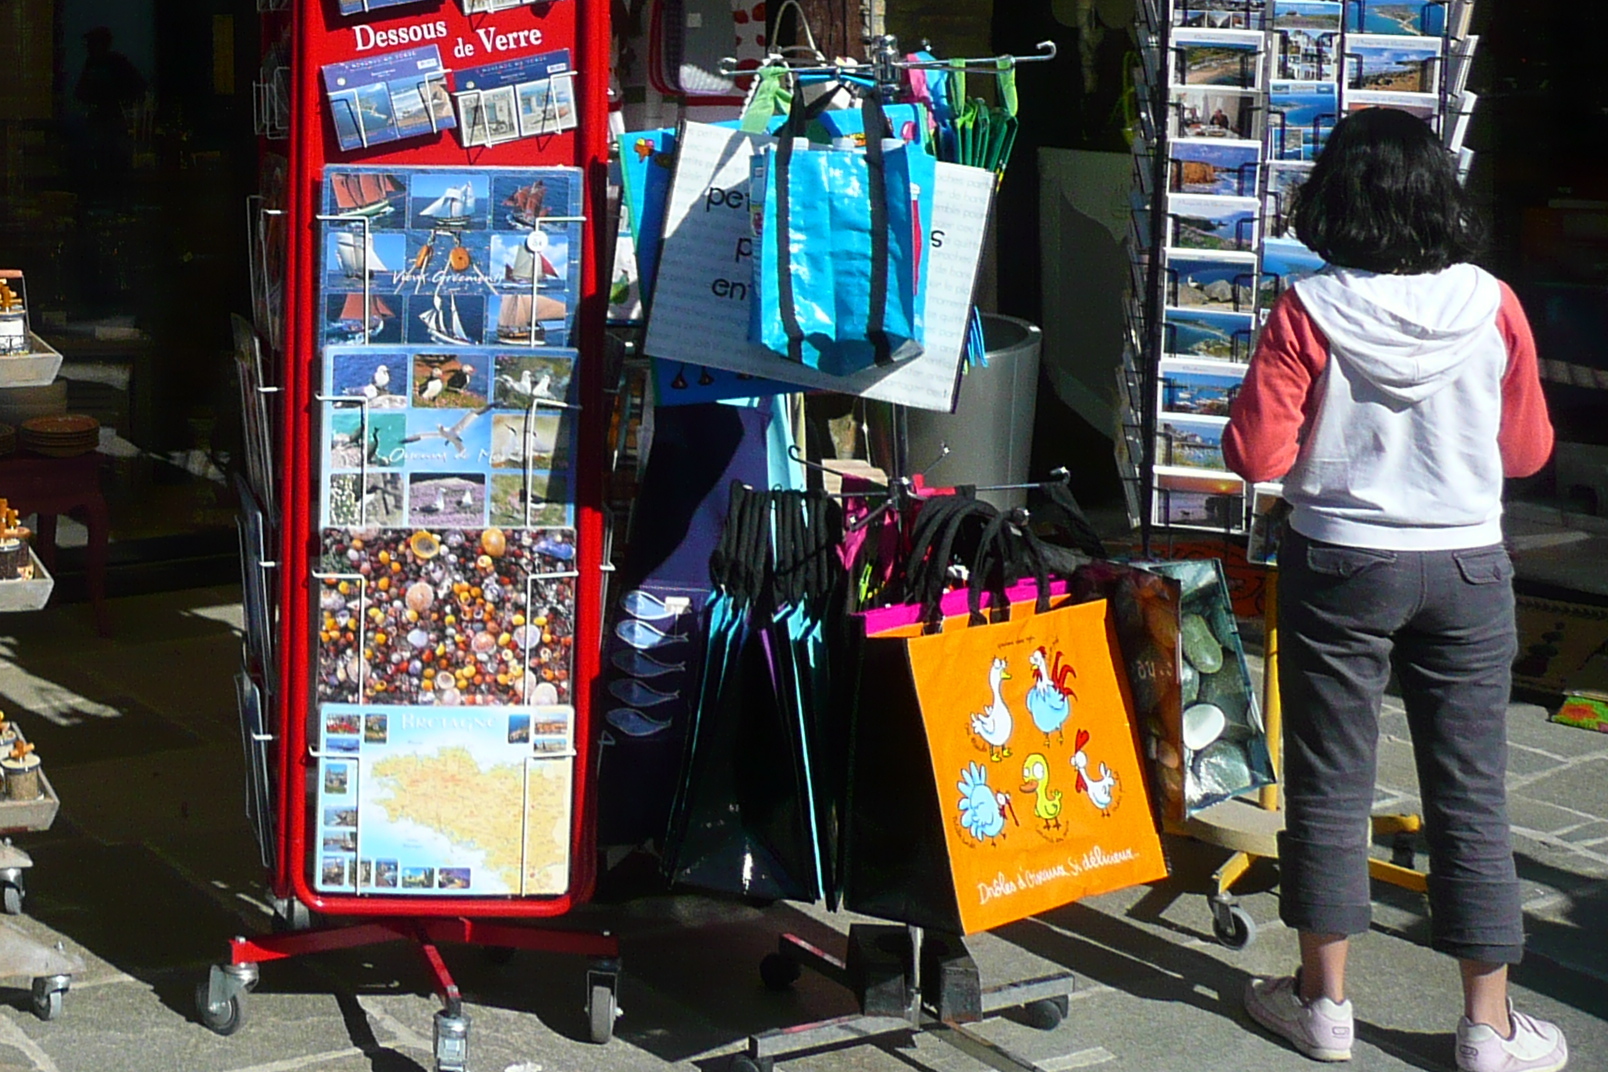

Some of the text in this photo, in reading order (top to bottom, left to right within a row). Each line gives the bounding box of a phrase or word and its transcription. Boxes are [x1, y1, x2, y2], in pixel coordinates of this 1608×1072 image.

[351, 19, 448, 52] Dessous
[453, 25, 543, 59] de Verre
